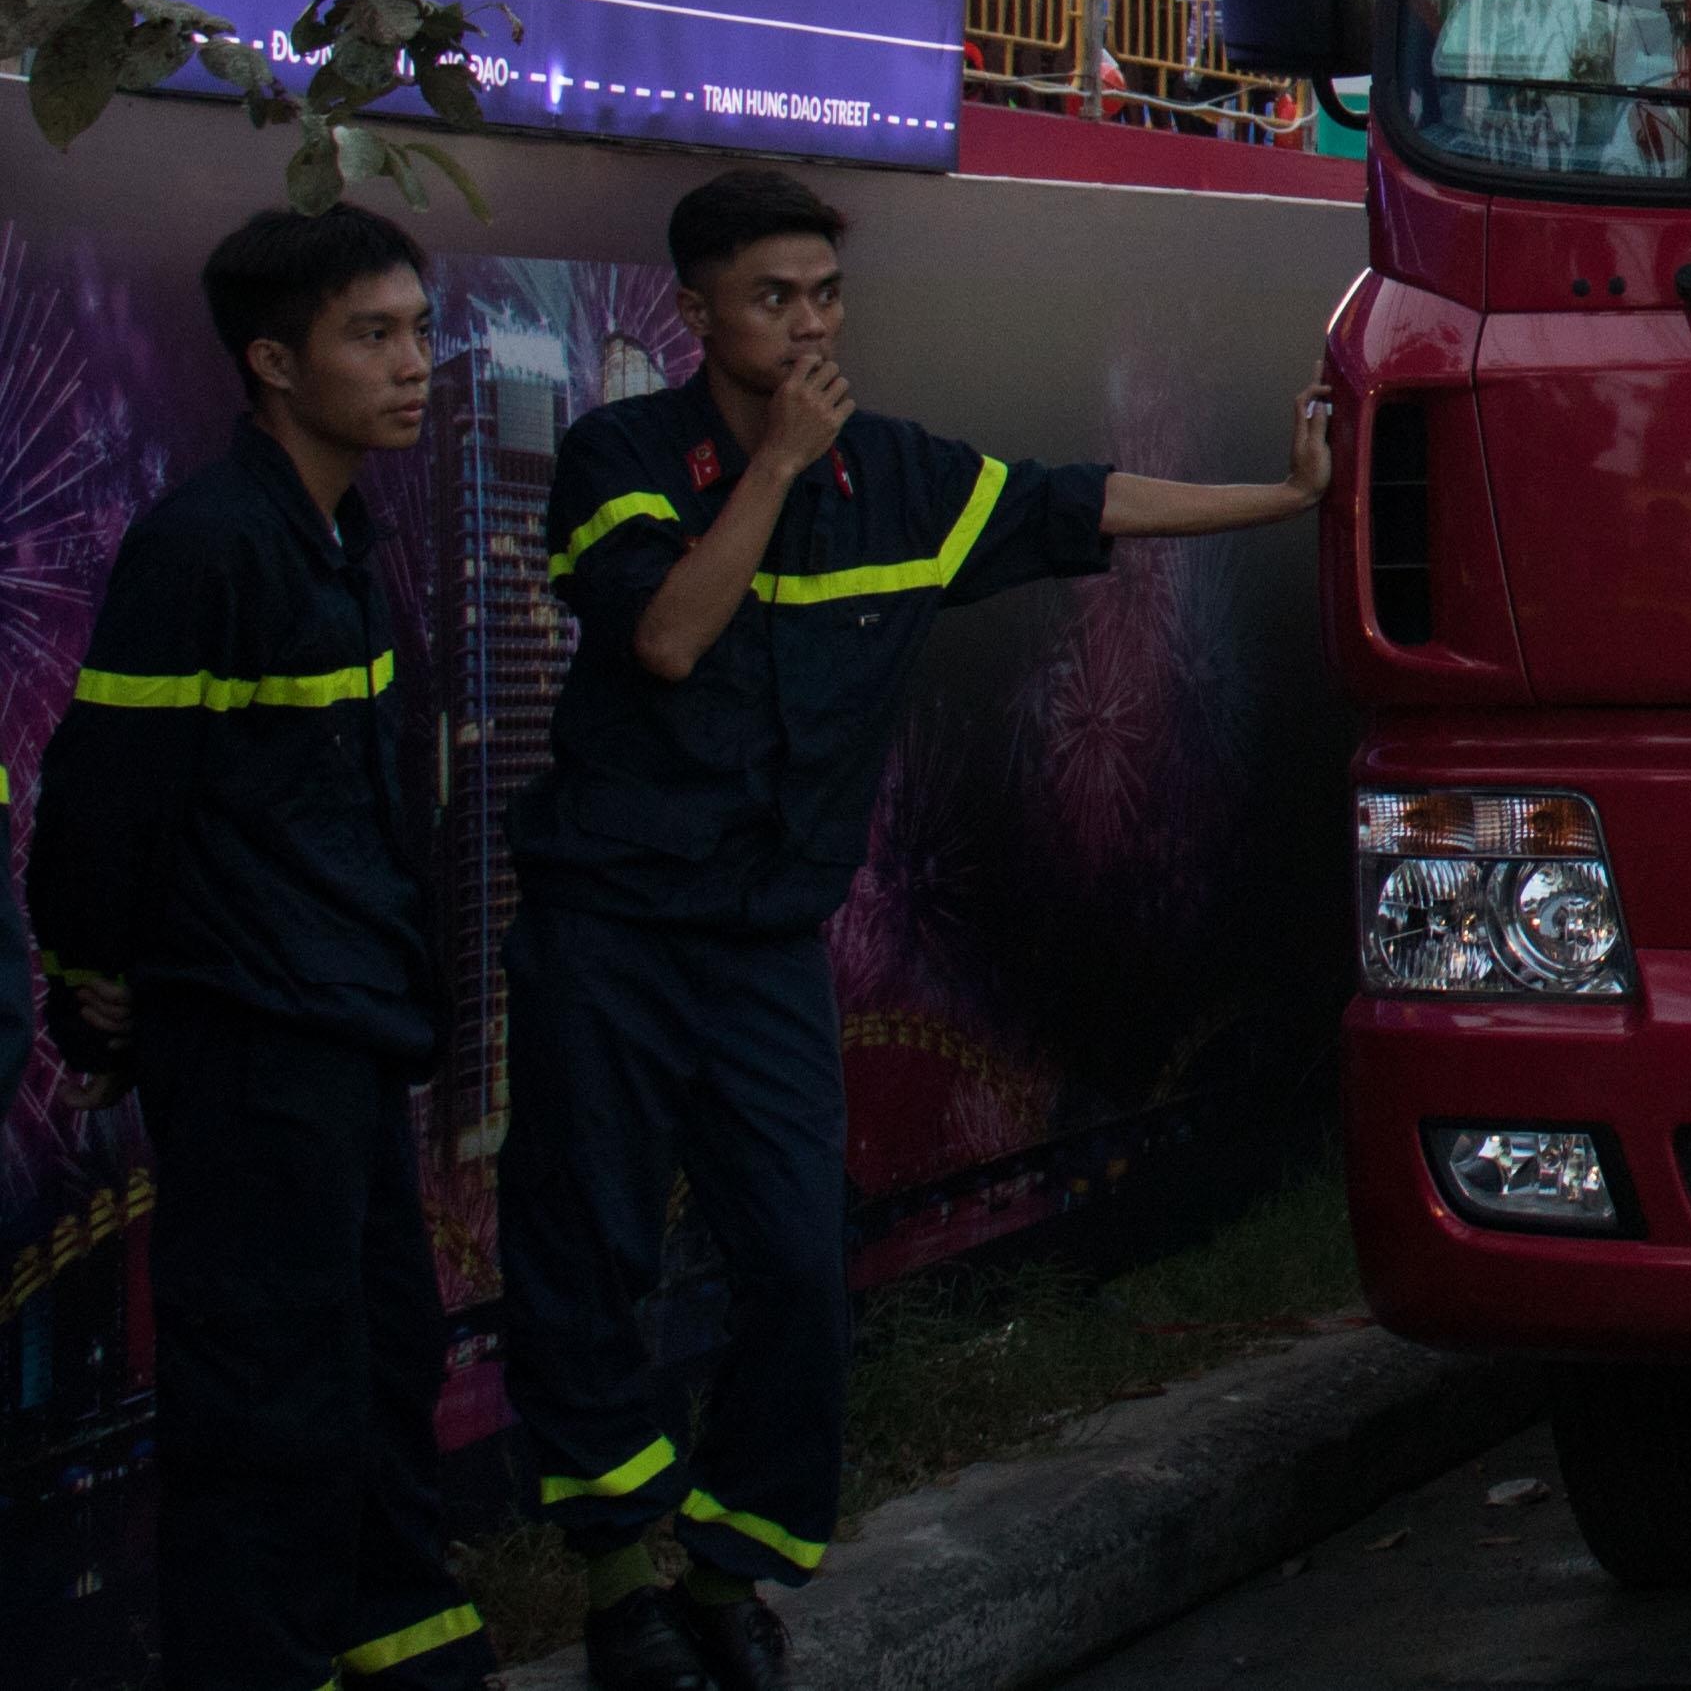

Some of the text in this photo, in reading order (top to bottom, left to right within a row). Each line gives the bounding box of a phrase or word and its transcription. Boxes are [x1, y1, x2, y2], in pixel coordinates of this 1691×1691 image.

[703, 84, 871, 127] TRAN HUNG DAO STREET
